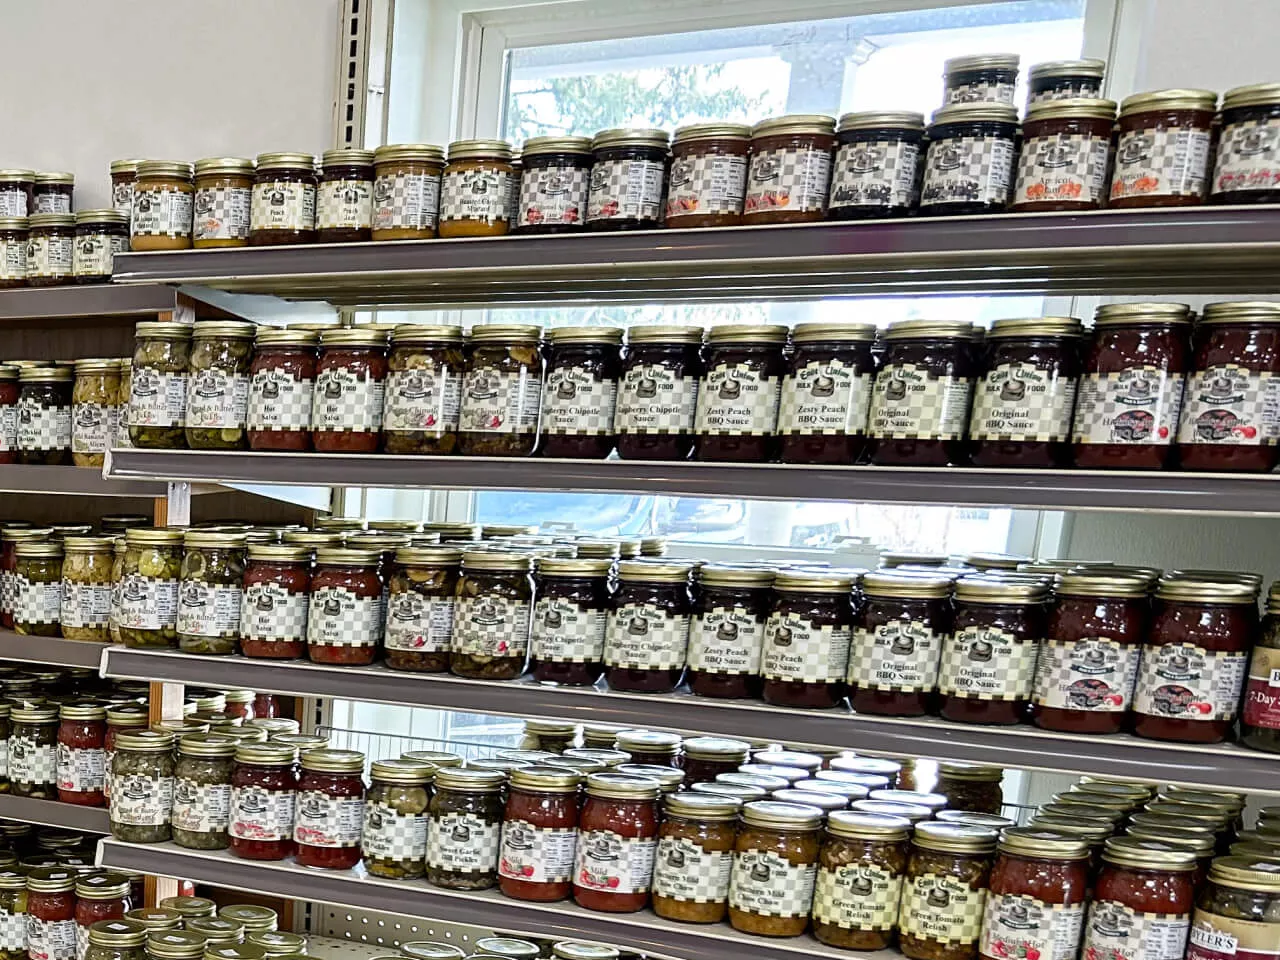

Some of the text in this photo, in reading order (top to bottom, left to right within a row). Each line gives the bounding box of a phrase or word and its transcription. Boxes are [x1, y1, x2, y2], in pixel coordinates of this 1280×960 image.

[707, 407, 751, 416] Zesty Peach
[798, 405, 846, 414] Zesty Peach
[878, 409, 909, 419] Original
[991, 410, 1029, 419] Original
[633, 414, 655, 422] Sauce
[708, 416, 749, 426] BBQ Sauce
[798, 414, 844, 424] BBQ Sauce
[891, 419, 914, 427] Sauce
[986, 420, 1034, 429] BBQ Sauce
[704, 646, 749, 656] Zesty Peach
[704, 656, 747, 665] BBQ Sauce
[780, 655, 803, 663] Peach
[780, 664, 800, 672] Sauce
[882, 662, 918, 672] Original
[876, 670, 920, 680] BBQ Sauce
[960, 668, 997, 679] Original
[954, 678, 1001, 689] BBQ Sauce
[1250, 691, 1275, 707] 7-Day
[832, 900, 886, 911] Green Tomato
[846, 910, 870, 919] Relish
[910, 911, 964, 926] Green Tomato
[922, 921, 947, 931] Relish
